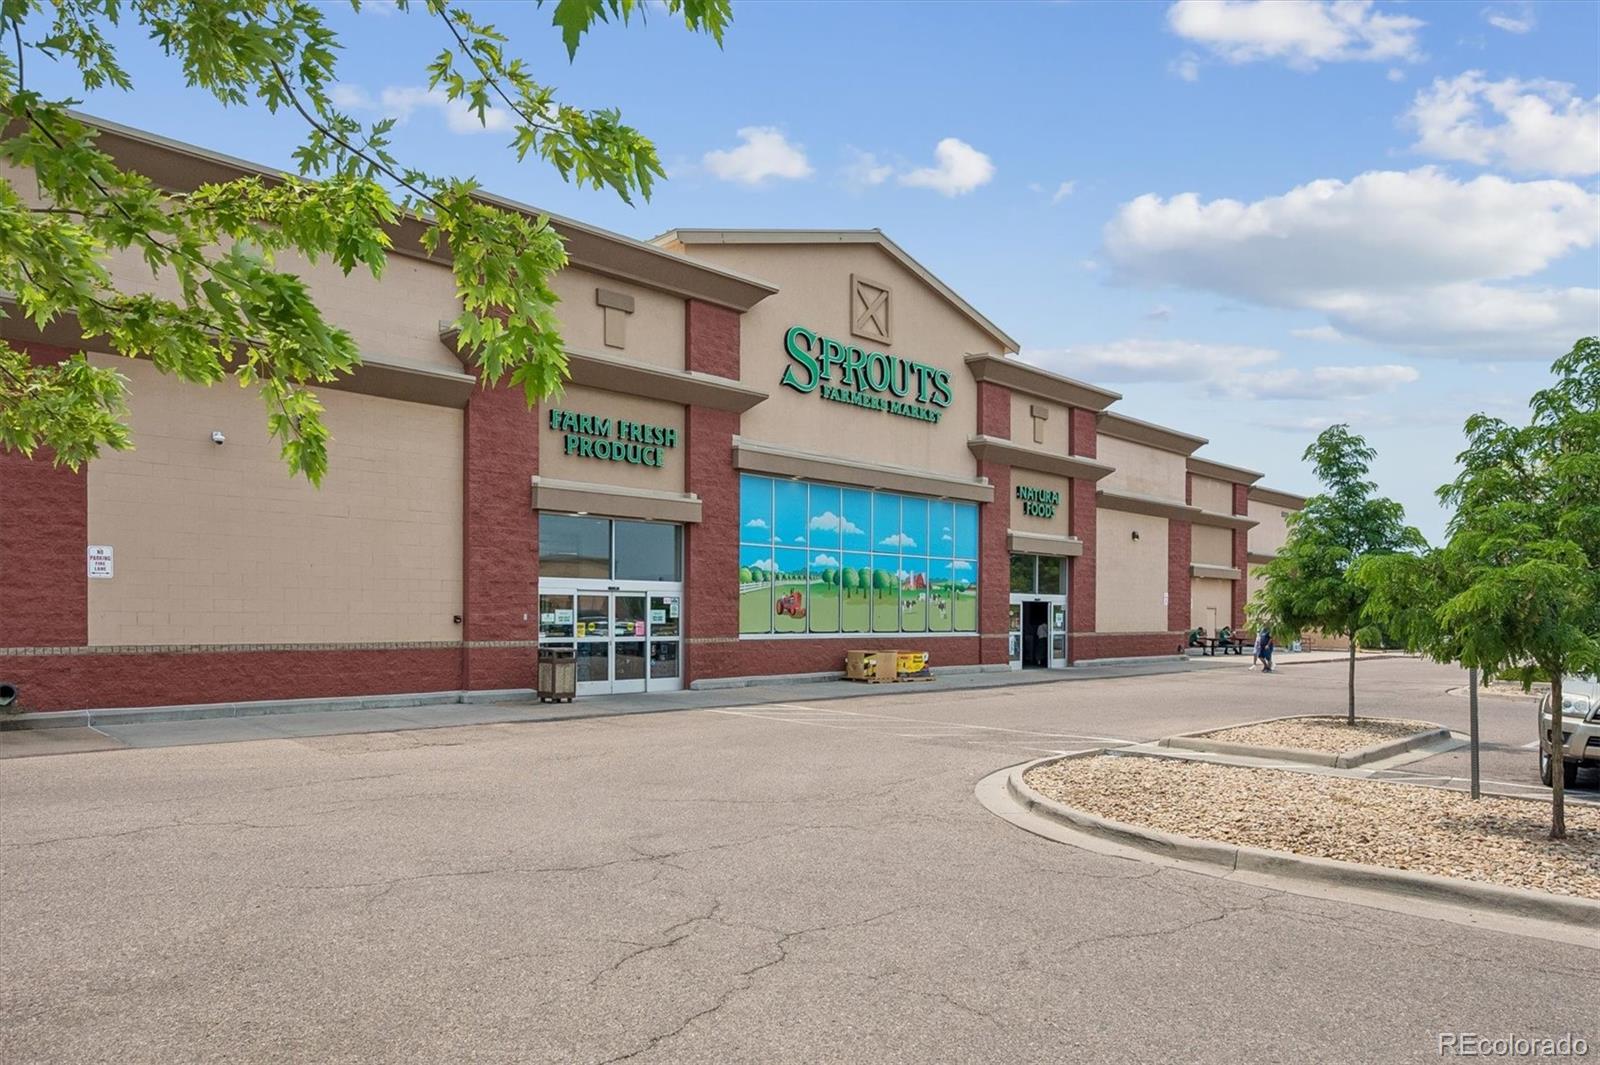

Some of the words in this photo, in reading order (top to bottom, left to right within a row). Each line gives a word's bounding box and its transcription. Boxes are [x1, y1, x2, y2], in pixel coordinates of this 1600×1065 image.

[780, 325, 954, 408] SPROUTS
[820, 384, 888, 411] FARMERS
[887, 399, 943, 424] MARKET
[550, 408, 613, 437] FARM
[618, 419, 678, 448] FRESH
[565, 433, 665, 467] PRODUCE
